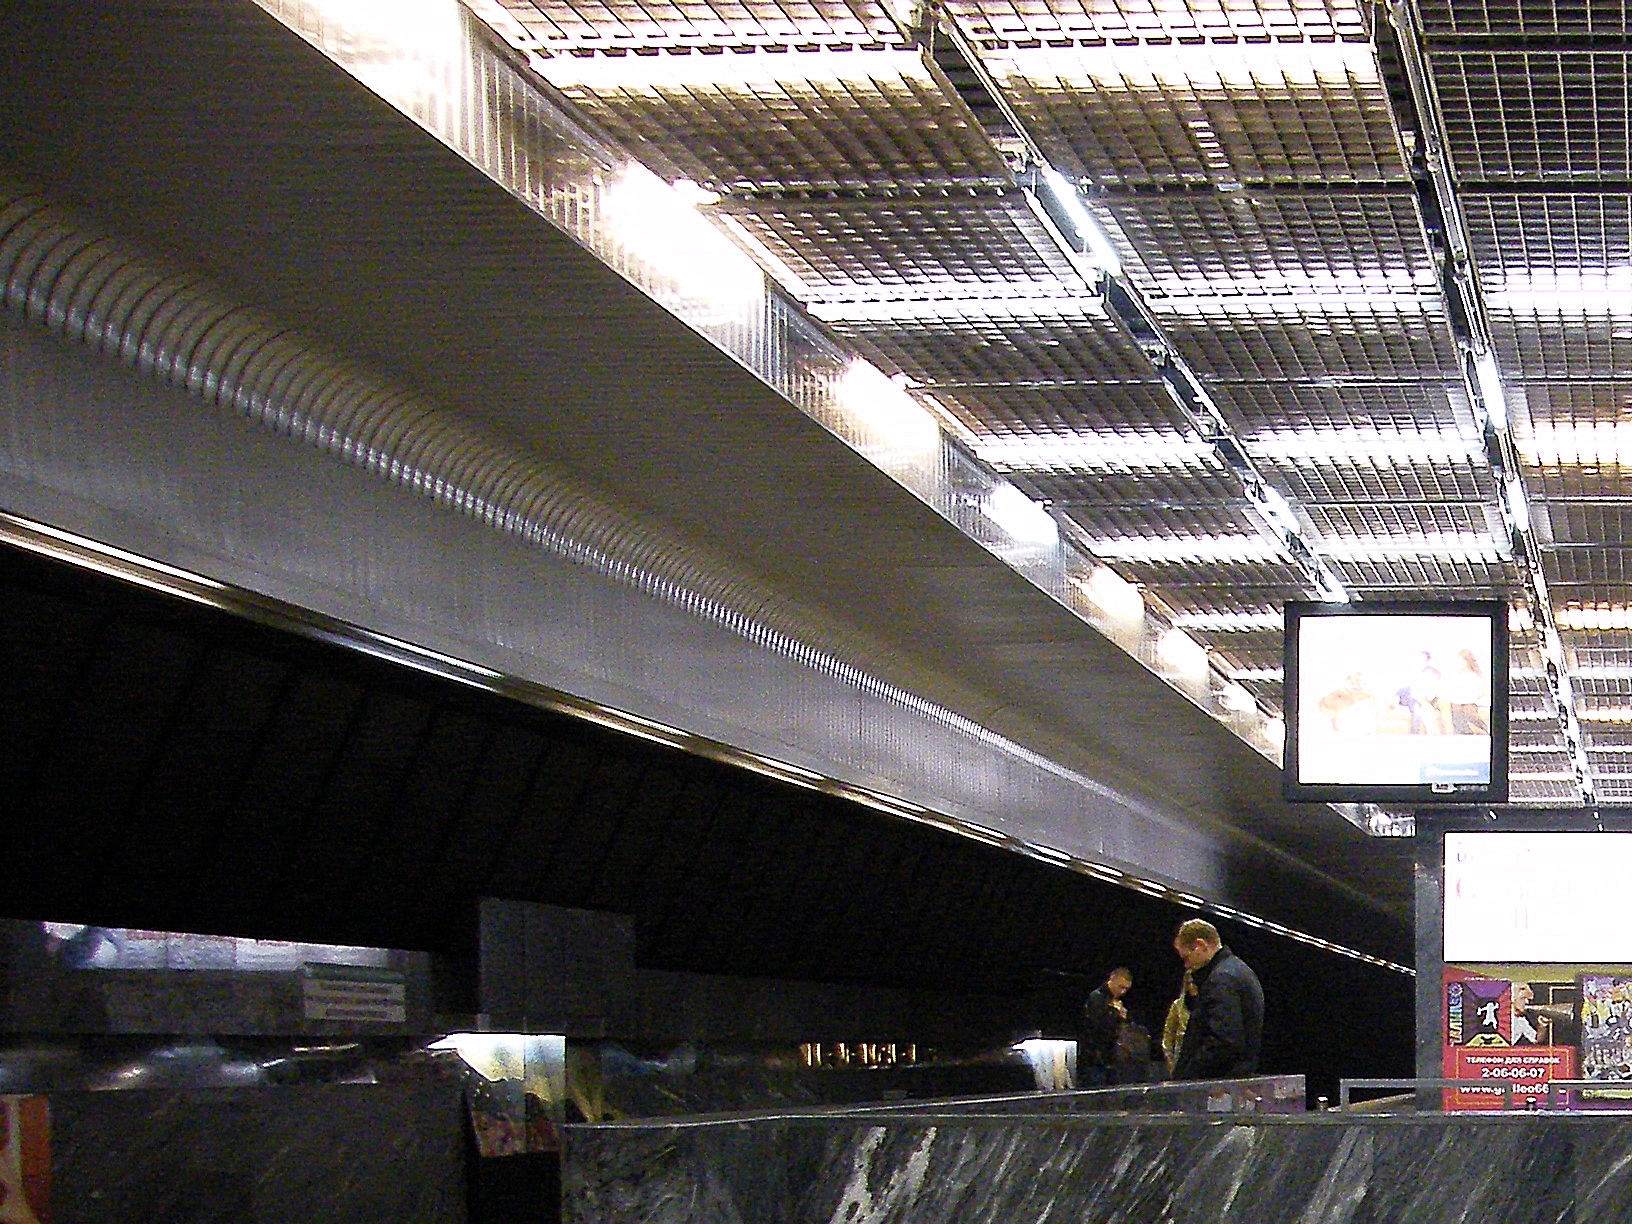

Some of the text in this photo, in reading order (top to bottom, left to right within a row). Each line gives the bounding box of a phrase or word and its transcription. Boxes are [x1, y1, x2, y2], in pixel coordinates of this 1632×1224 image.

[1465, 1056, 1561, 1065] ТЕЛЕФОН ДЛЯ СПРАВОК
[1481, 1067, 1545, 1078] 2-06-06-07
